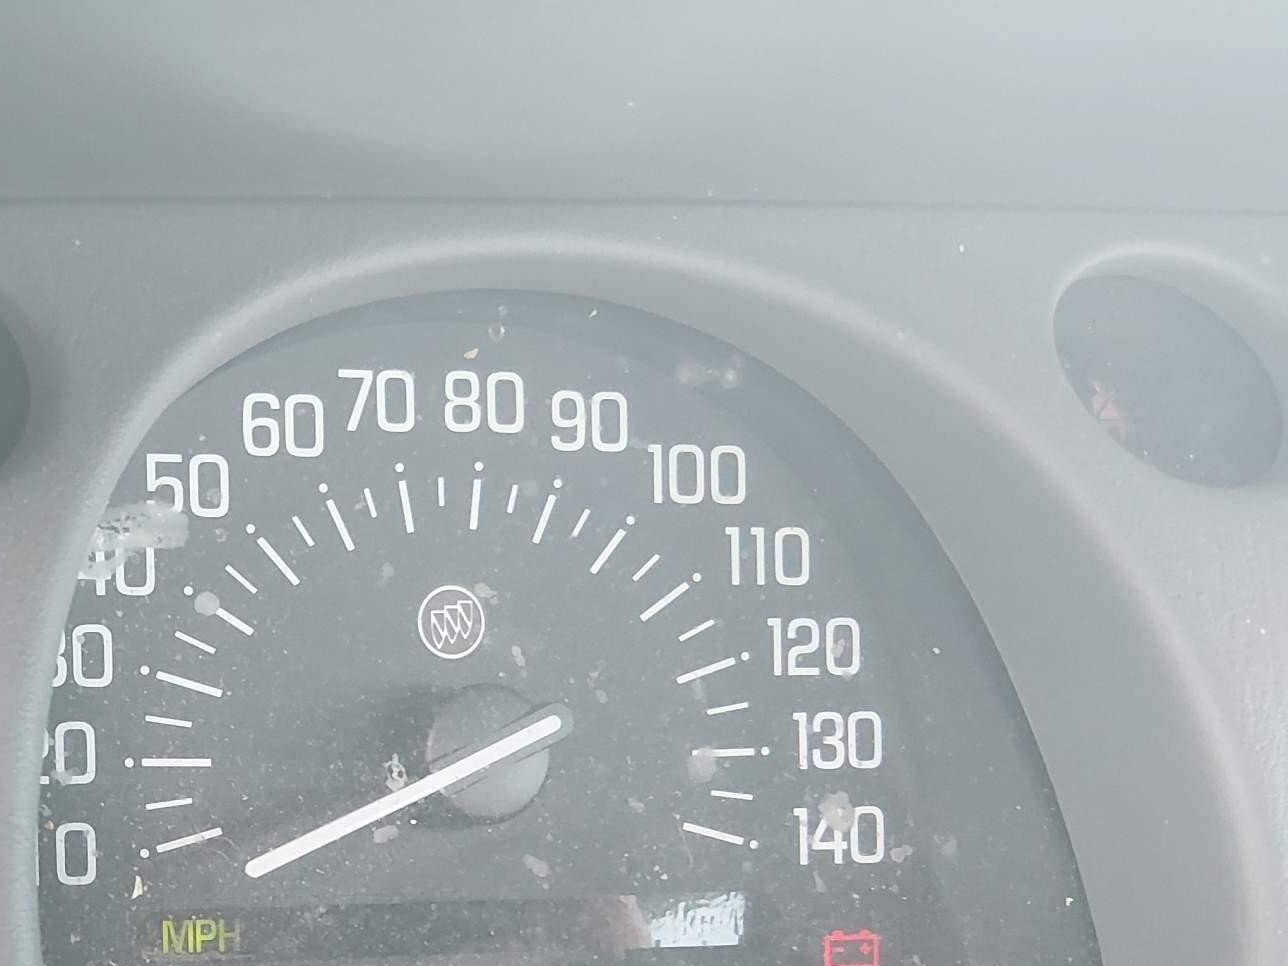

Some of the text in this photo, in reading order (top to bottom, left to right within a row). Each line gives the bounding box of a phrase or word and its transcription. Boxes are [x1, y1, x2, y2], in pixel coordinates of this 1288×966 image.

[242, 392, 325, 458] 60
[338, 368, 416, 433] 70
[444, 370, 525, 434] 80
[550, 390, 629, 452] 90
[145, 453, 230, 518] 50
[647, 444, 747, 505] 100
[725, 526, 811, 586] 110
[767, 617, 861, 677] 120
[792, 711, 883, 770] 130
[793, 805, 885, 866] 140
[161, 918, 242, 955] MPH
